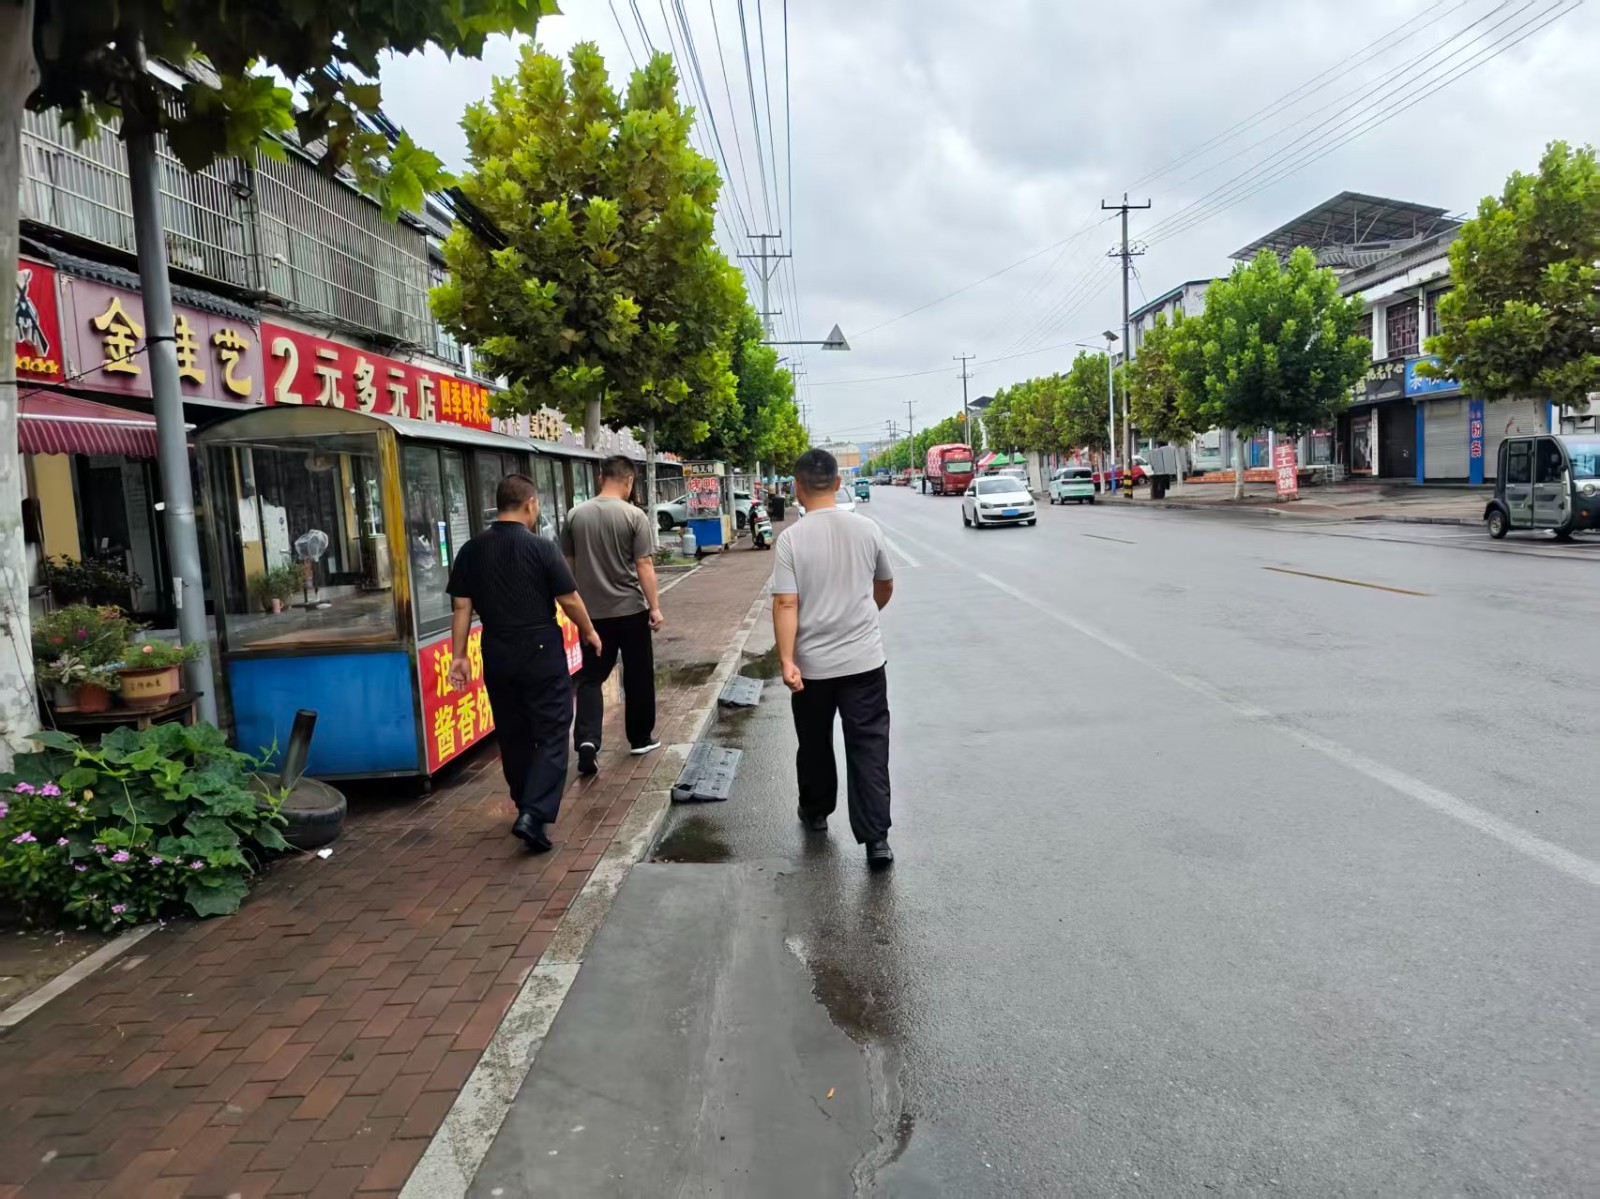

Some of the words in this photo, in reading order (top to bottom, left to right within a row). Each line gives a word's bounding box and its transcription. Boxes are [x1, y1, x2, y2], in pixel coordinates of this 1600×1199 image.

[271, 336, 436, 422] 2元多元店
[440, 379, 491, 425] 四季鲜水果
[1275, 445, 1294, 490] 手工煎饼
[434, 685, 495, 762] 酱香饼
